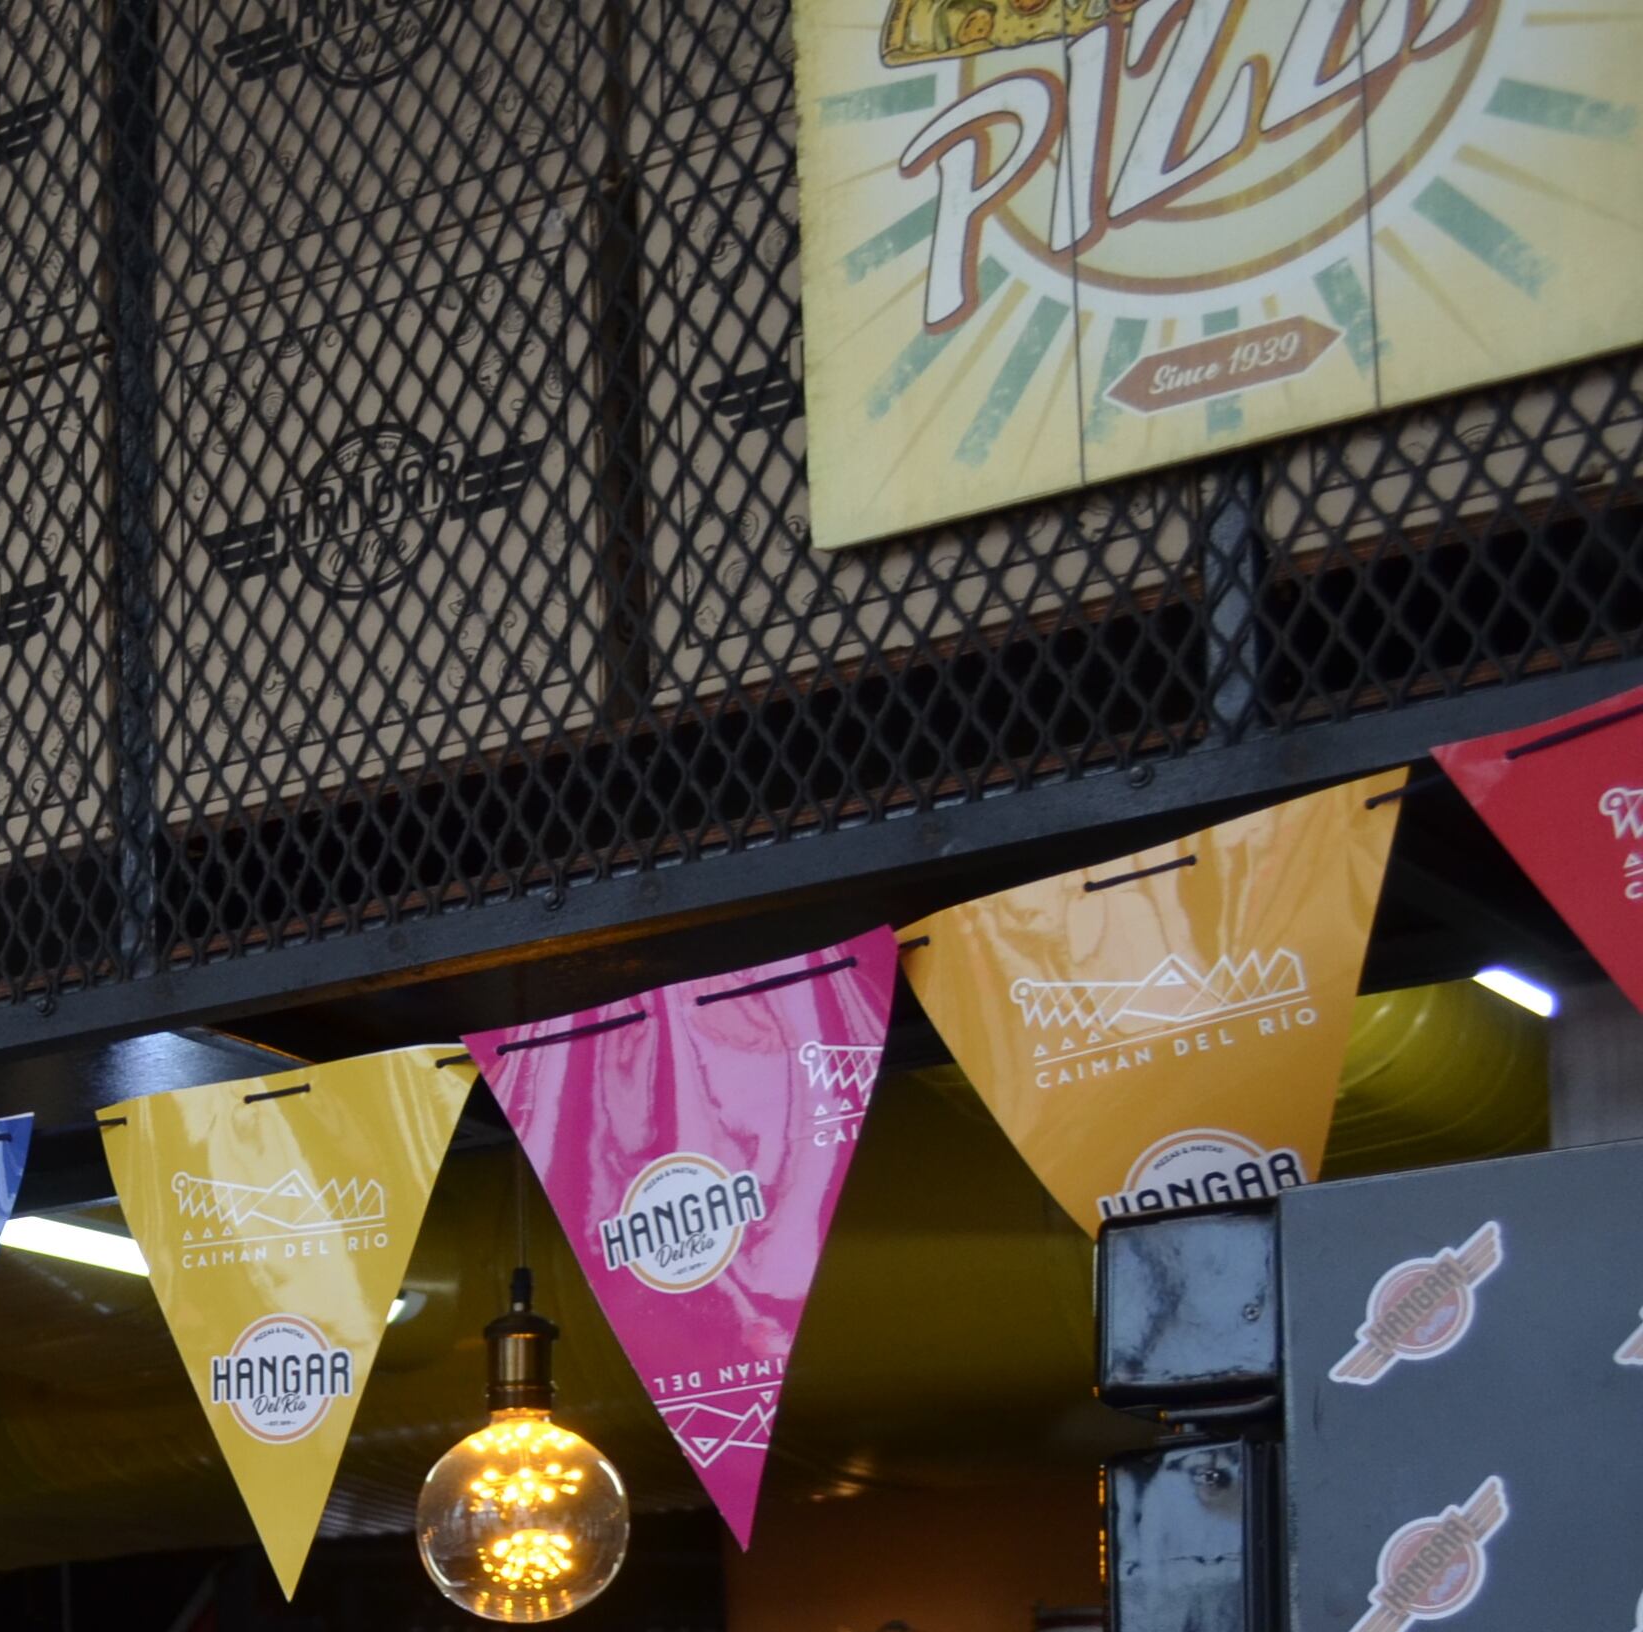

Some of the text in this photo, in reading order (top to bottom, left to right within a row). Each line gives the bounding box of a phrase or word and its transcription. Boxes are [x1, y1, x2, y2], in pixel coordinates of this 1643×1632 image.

[1149, 331, 1301, 397] Since 1939
[1035, 1005, 1318, 1090] CAIMÁN DEL RÍO
[181, 1229, 390, 1270] CAIMÁN DEL RÍO
[602, 1175, 762, 1268] HANGAR
[654, 1242, 684, 1268] Del
[1369, 1260, 1465, 1347] HANGAR
[213, 1352, 350, 1402] HANGAR
[252, 1394, 280, 1416] Del
[1383, 1513, 1473, 1609] HANGAR
